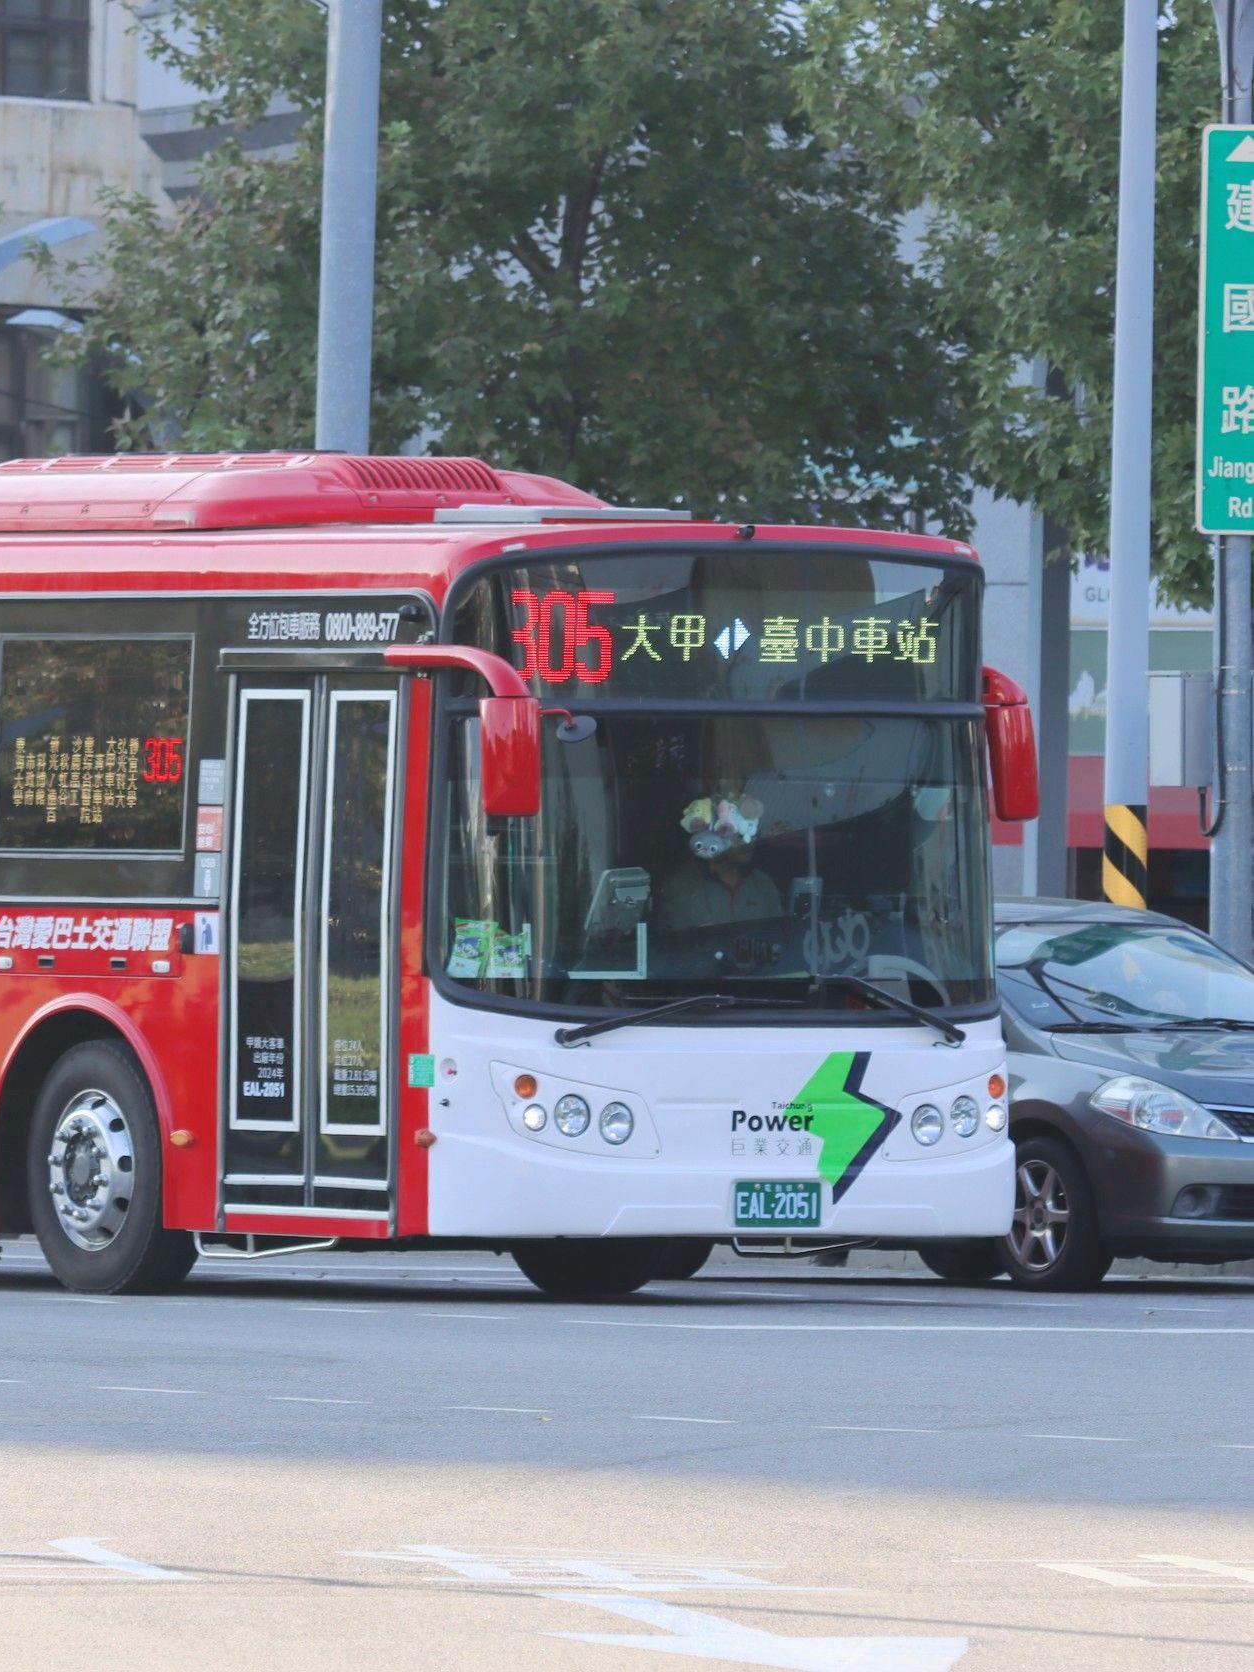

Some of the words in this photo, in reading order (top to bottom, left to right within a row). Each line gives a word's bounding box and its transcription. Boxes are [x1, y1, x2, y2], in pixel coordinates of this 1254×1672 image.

[248, 612, 321, 641] 全方位包車服務
[325, 612, 400, 641] 0800-889-577
[510, 590, 615, 684] 305
[621, 614, 706, 662] 大甲
[758, 616, 939, 665] 臺中車站
[143, 736, 183, 783] 305
[103, 736, 117, 806] 大甲車站
[257, 1067, 284, 1080] 2024年
[243, 1080, 285, 1098] EAL-2051
[771, 1101, 813, 1113] Taichung
[731, 1110, 814, 1132] Power
[731, 1137, 813, 1156] 巨業交通
